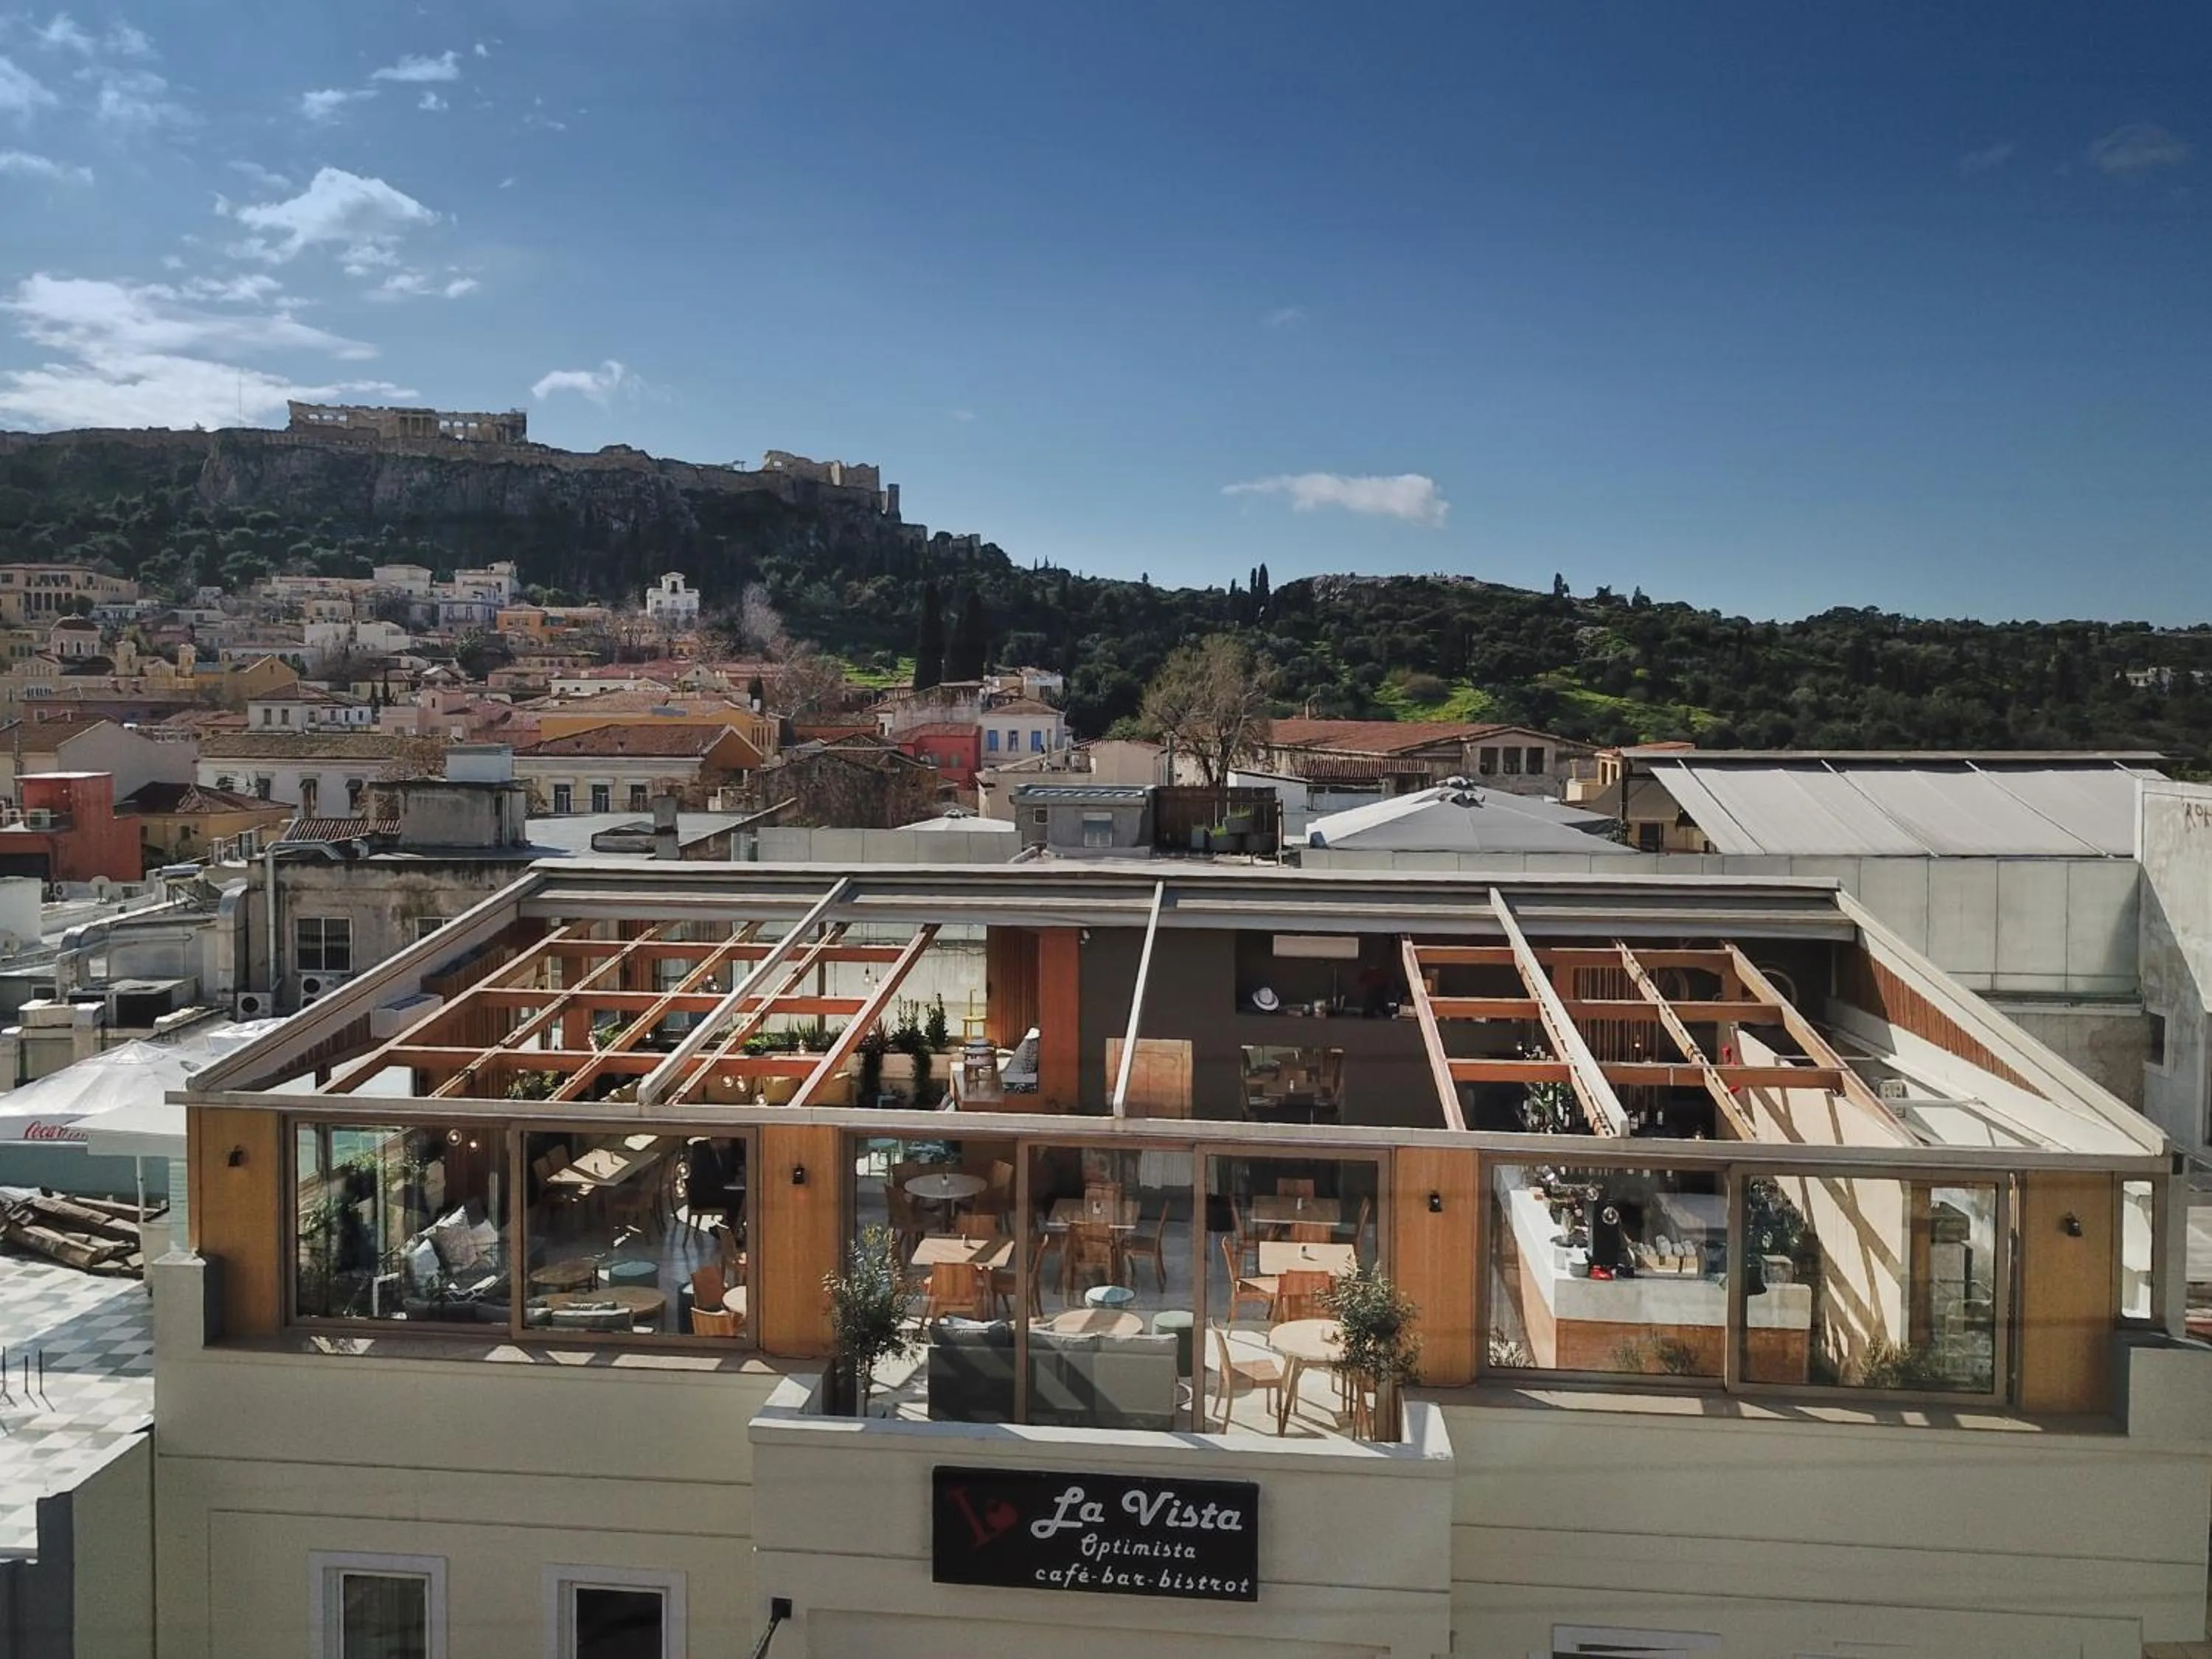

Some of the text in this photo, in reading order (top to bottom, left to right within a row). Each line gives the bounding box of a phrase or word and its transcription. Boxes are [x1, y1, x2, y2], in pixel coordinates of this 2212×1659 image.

[1030, 1486, 1105, 1539] La
[1121, 1489, 1242, 1531] Vista
[1081, 1533, 1196, 1562] Optimista
